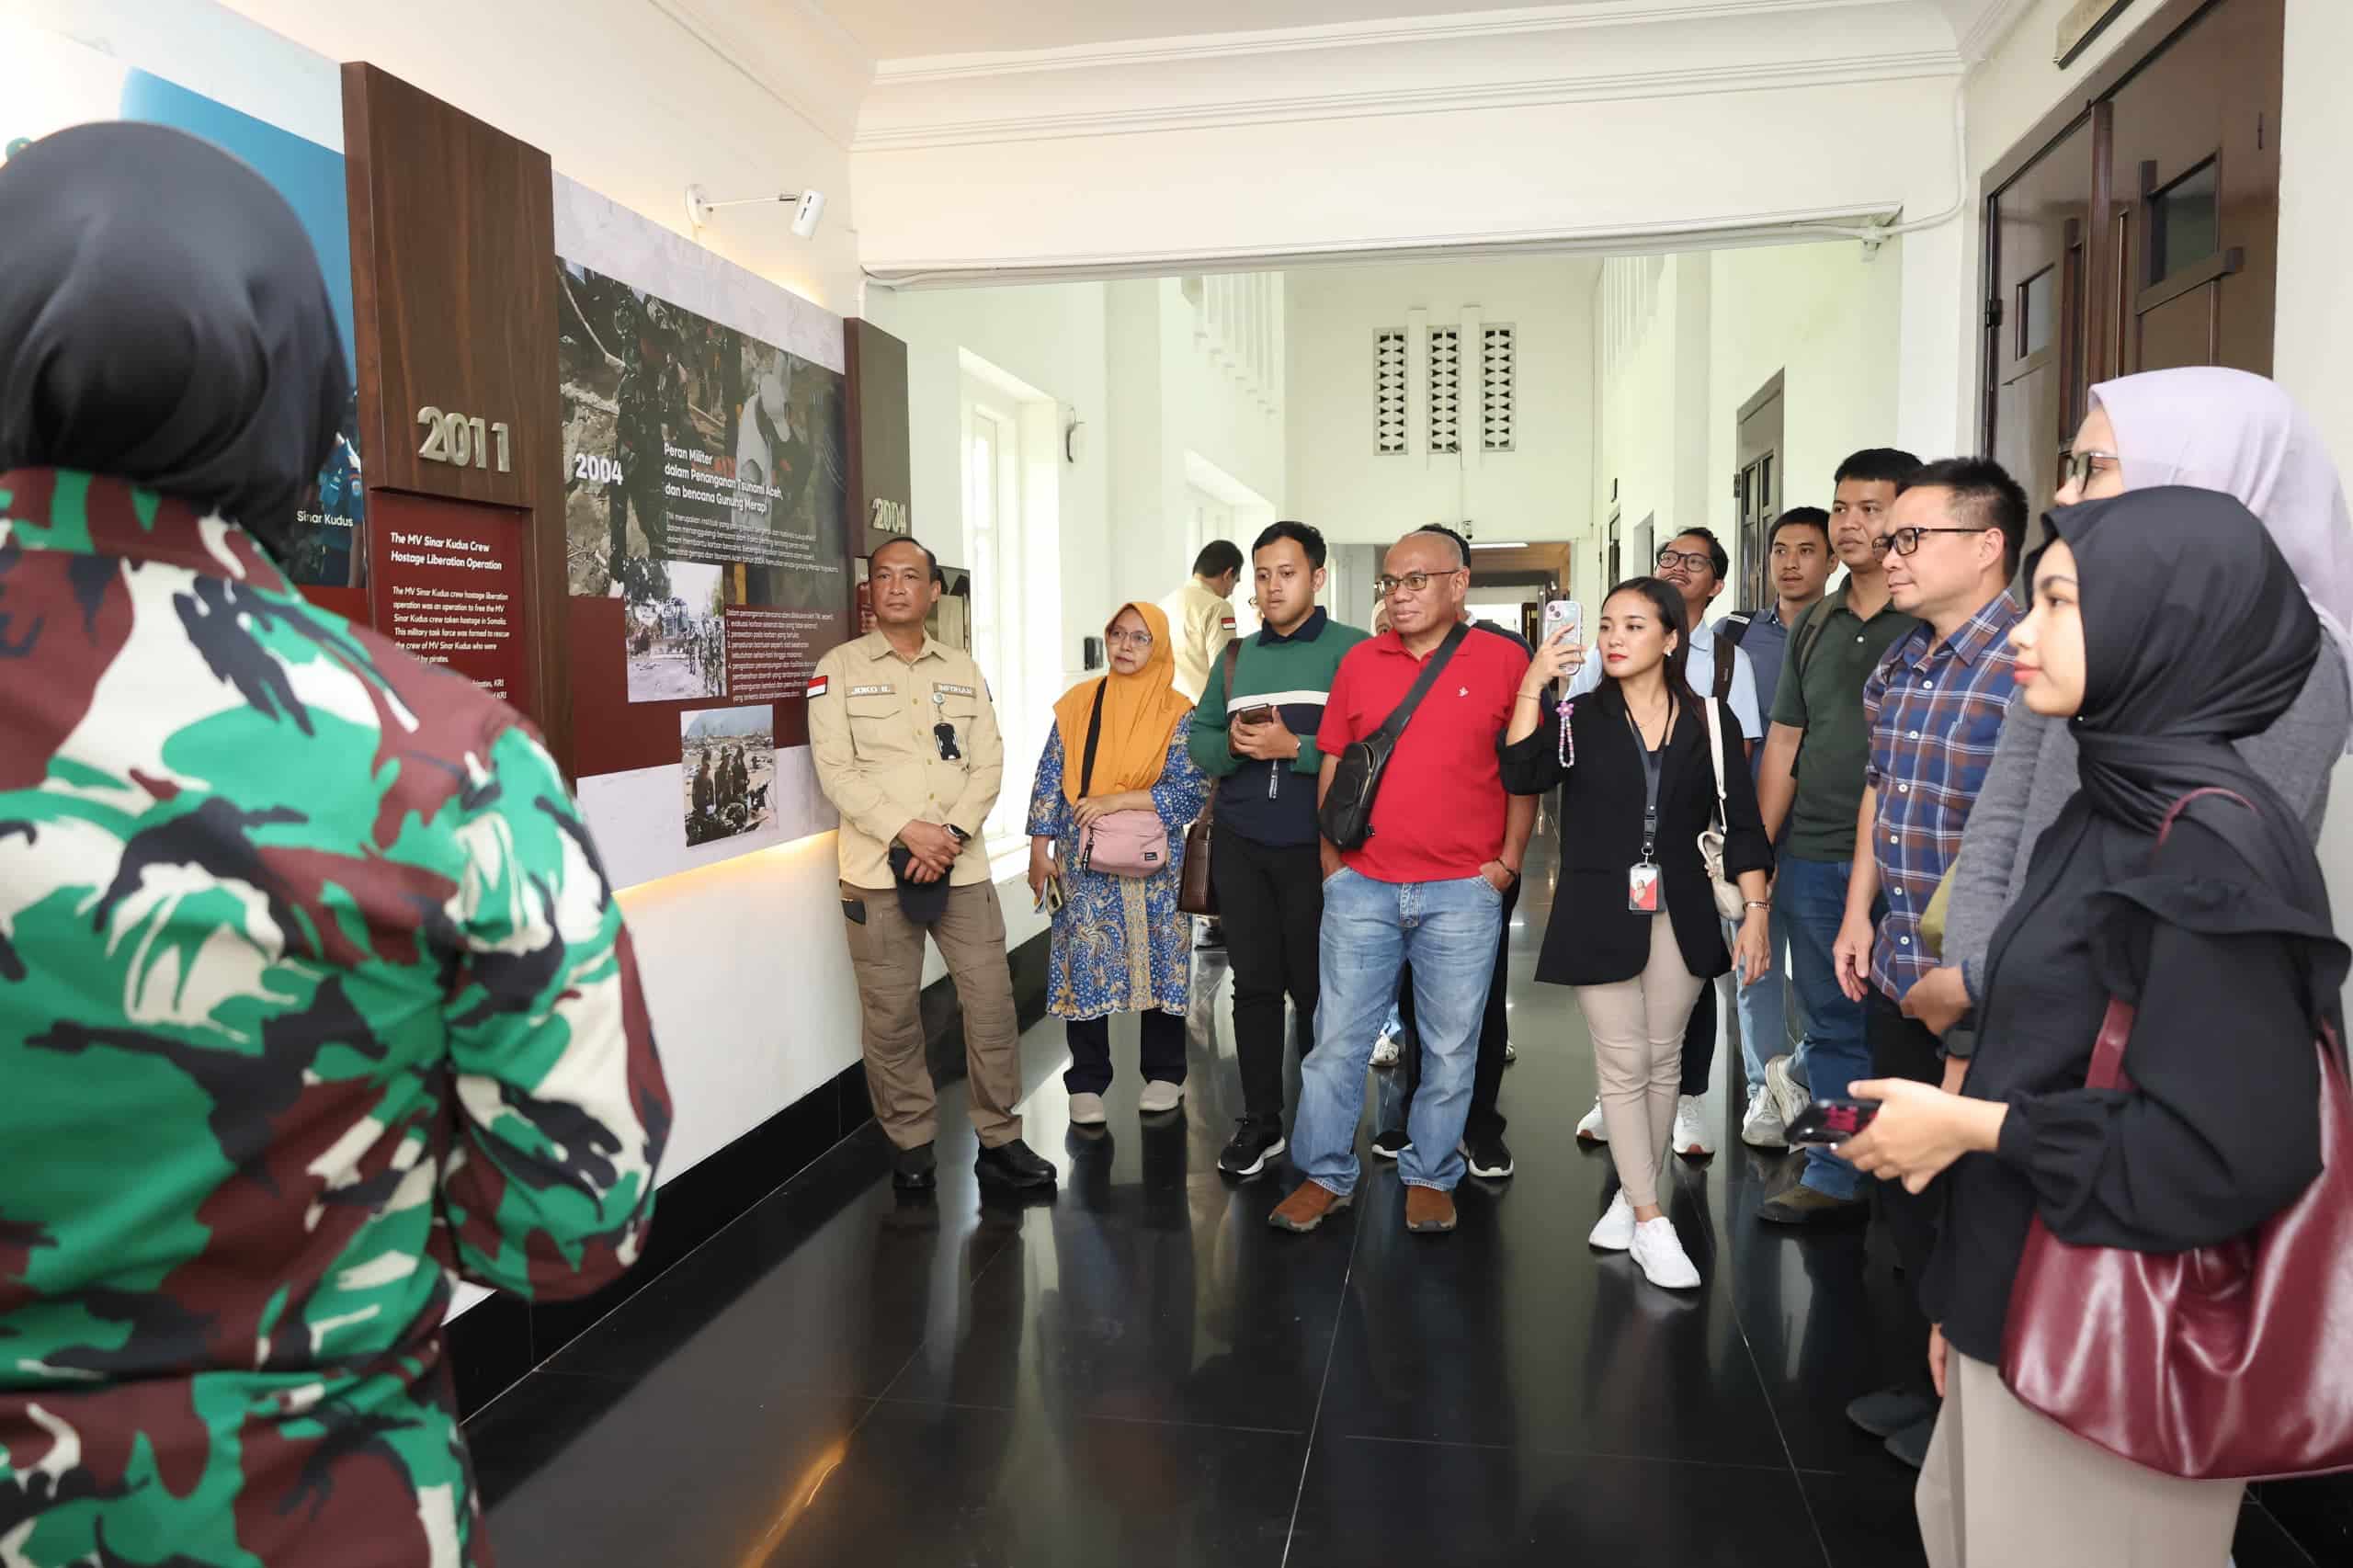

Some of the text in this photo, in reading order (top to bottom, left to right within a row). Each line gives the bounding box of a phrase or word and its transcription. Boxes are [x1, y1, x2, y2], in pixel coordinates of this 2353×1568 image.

[417, 406, 511, 472] 2011
[664, 441, 713, 465] Peran Militer
[574, 452, 624, 486] 2004
[665, 462, 689, 480] dalam
[690, 469, 736, 488] Penanganan
[737, 478, 766, 495] Tsunami
[665, 481, 767, 515] dan bencana Gunung Merapi
[297, 510, 354, 528] Sinar Kudus
[872, 497, 907, 535] 2004
[391, 532, 490, 552] The MV Sinar Kudus Crew
[391, 551, 502, 571] Hostage Liberation Operation
[392, 585, 404, 596] The
